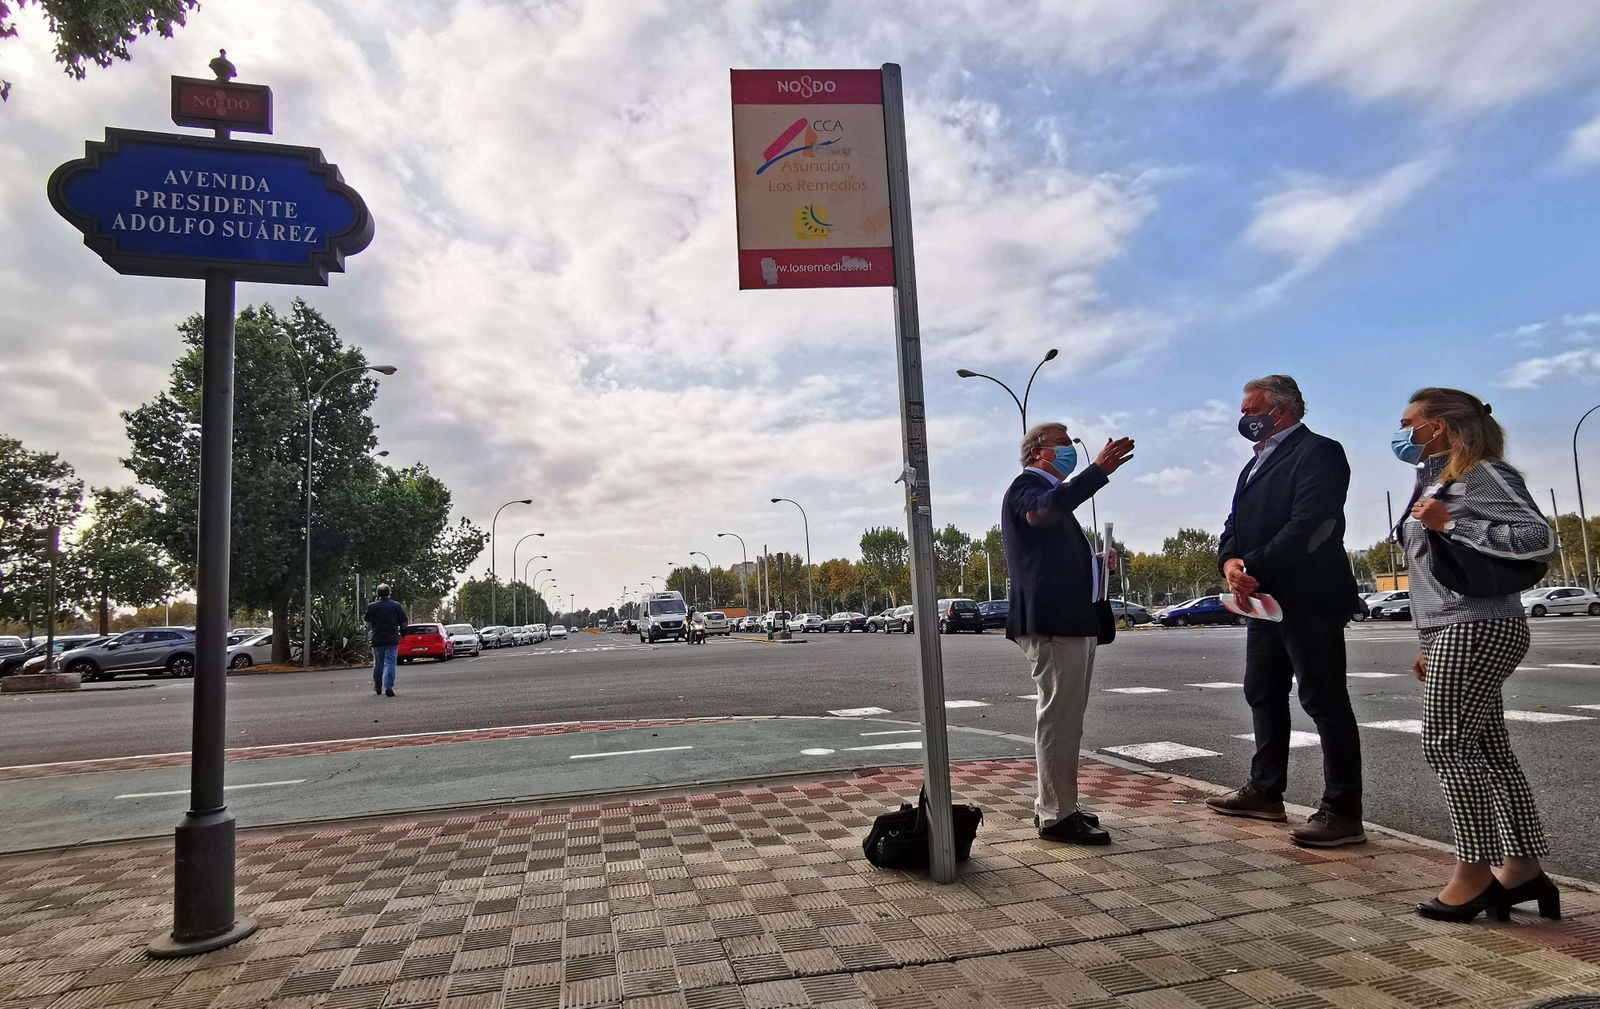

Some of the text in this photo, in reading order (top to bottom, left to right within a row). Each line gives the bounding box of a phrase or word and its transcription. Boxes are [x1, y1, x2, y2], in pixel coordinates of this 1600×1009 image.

[813, 119, 844, 132] CCA
[781, 158, 850, 173] Asunción
[164, 169, 271, 193] AVENIDA
[768, 178, 868, 193] Los Remedios
[135, 190, 297, 219] PRESIDENTE
[112, 213, 317, 243] ADOLFO SUÁREZ
